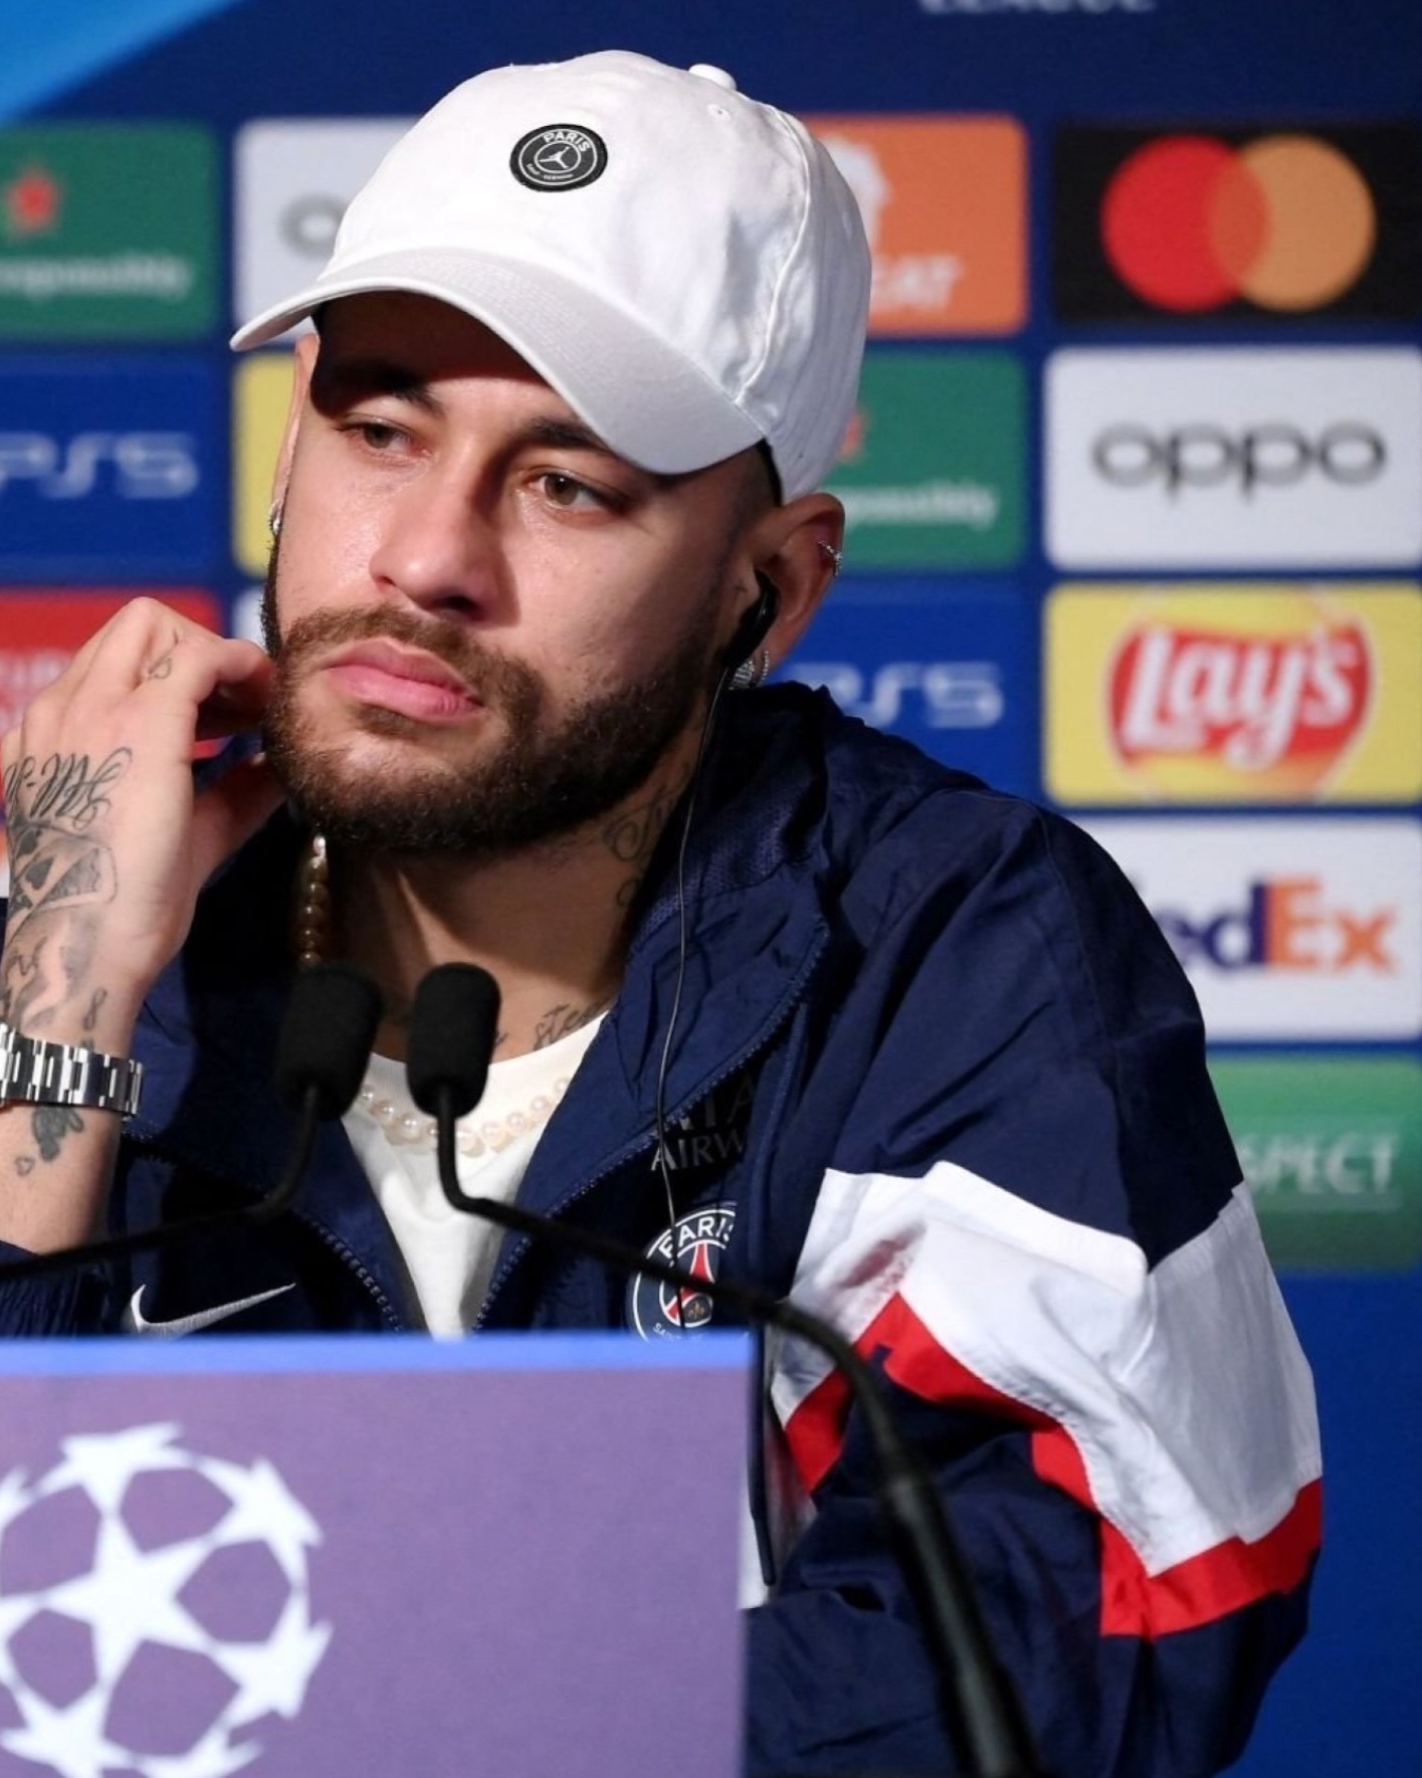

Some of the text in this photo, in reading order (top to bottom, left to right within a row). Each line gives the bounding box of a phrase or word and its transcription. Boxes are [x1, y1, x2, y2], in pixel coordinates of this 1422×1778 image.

[543, 130, 592, 152] PARIS
[1092, 423, 1386, 499] oppo
[1152, 875, 1400, 974] edEx
[651, 1129, 744, 1170] AIRW
[1236, 1132, 1401, 1194] SPECT
